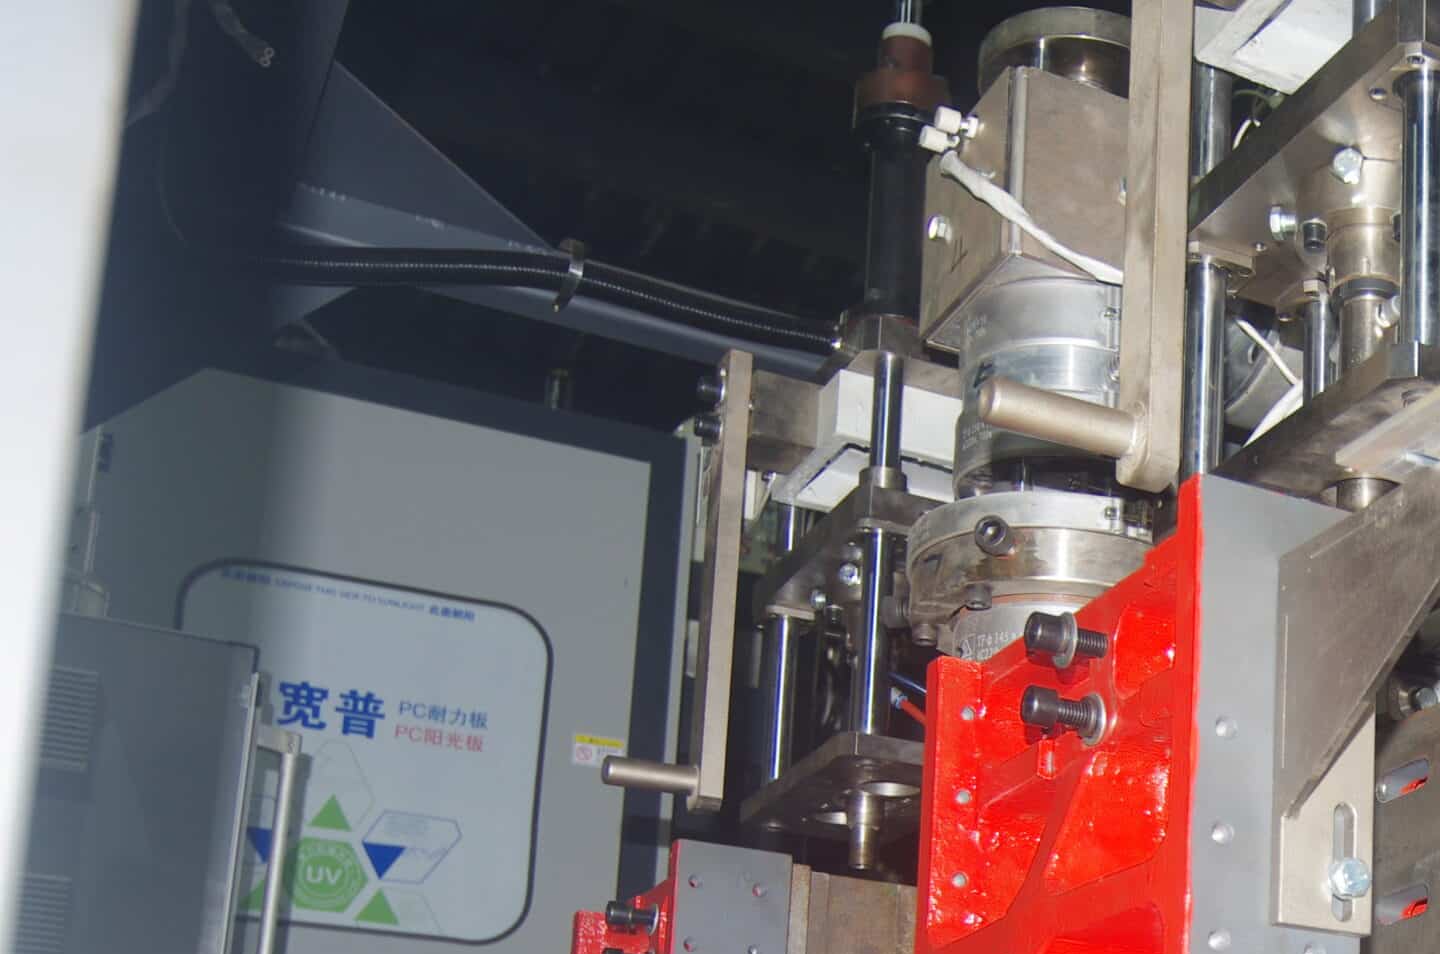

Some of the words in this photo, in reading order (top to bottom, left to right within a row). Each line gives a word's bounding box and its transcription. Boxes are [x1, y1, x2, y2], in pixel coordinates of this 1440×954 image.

[277, 681, 385, 739] 宽普
[399, 700, 488, 729] PC耐力板
[394, 724, 484, 753] PC阳光板
[305, 864, 342, 886] UV
